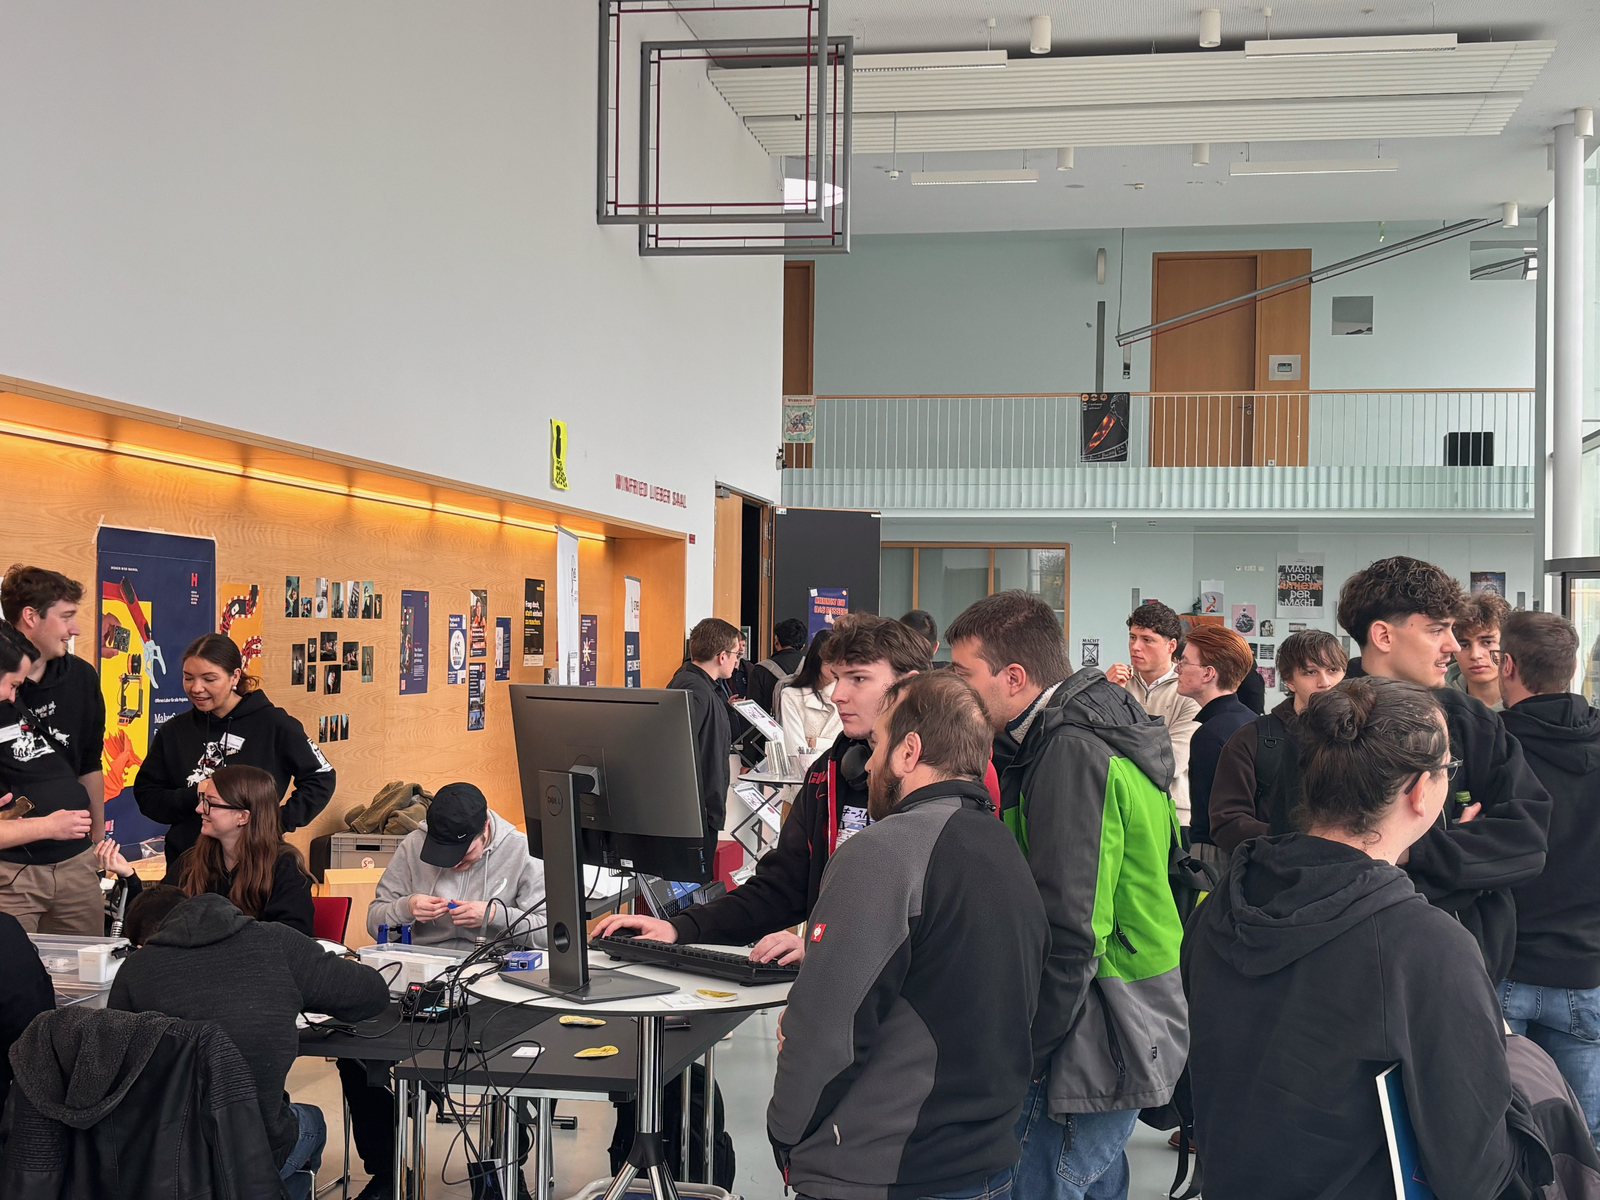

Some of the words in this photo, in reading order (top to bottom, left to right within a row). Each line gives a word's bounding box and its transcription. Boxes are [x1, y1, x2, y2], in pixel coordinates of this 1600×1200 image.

[615, 474, 648, 497] WINFRIED
[650, 485, 671, 503] LIEBER
[672, 491, 687, 509] SAAL
[1285, 565, 1315, 573] MACHT
[1290, 574, 1311, 582] DER
[1290, 590, 1311, 598] DER
[1285, 599, 1315, 607] MACHT
[547, 796, 561, 805] DELL
